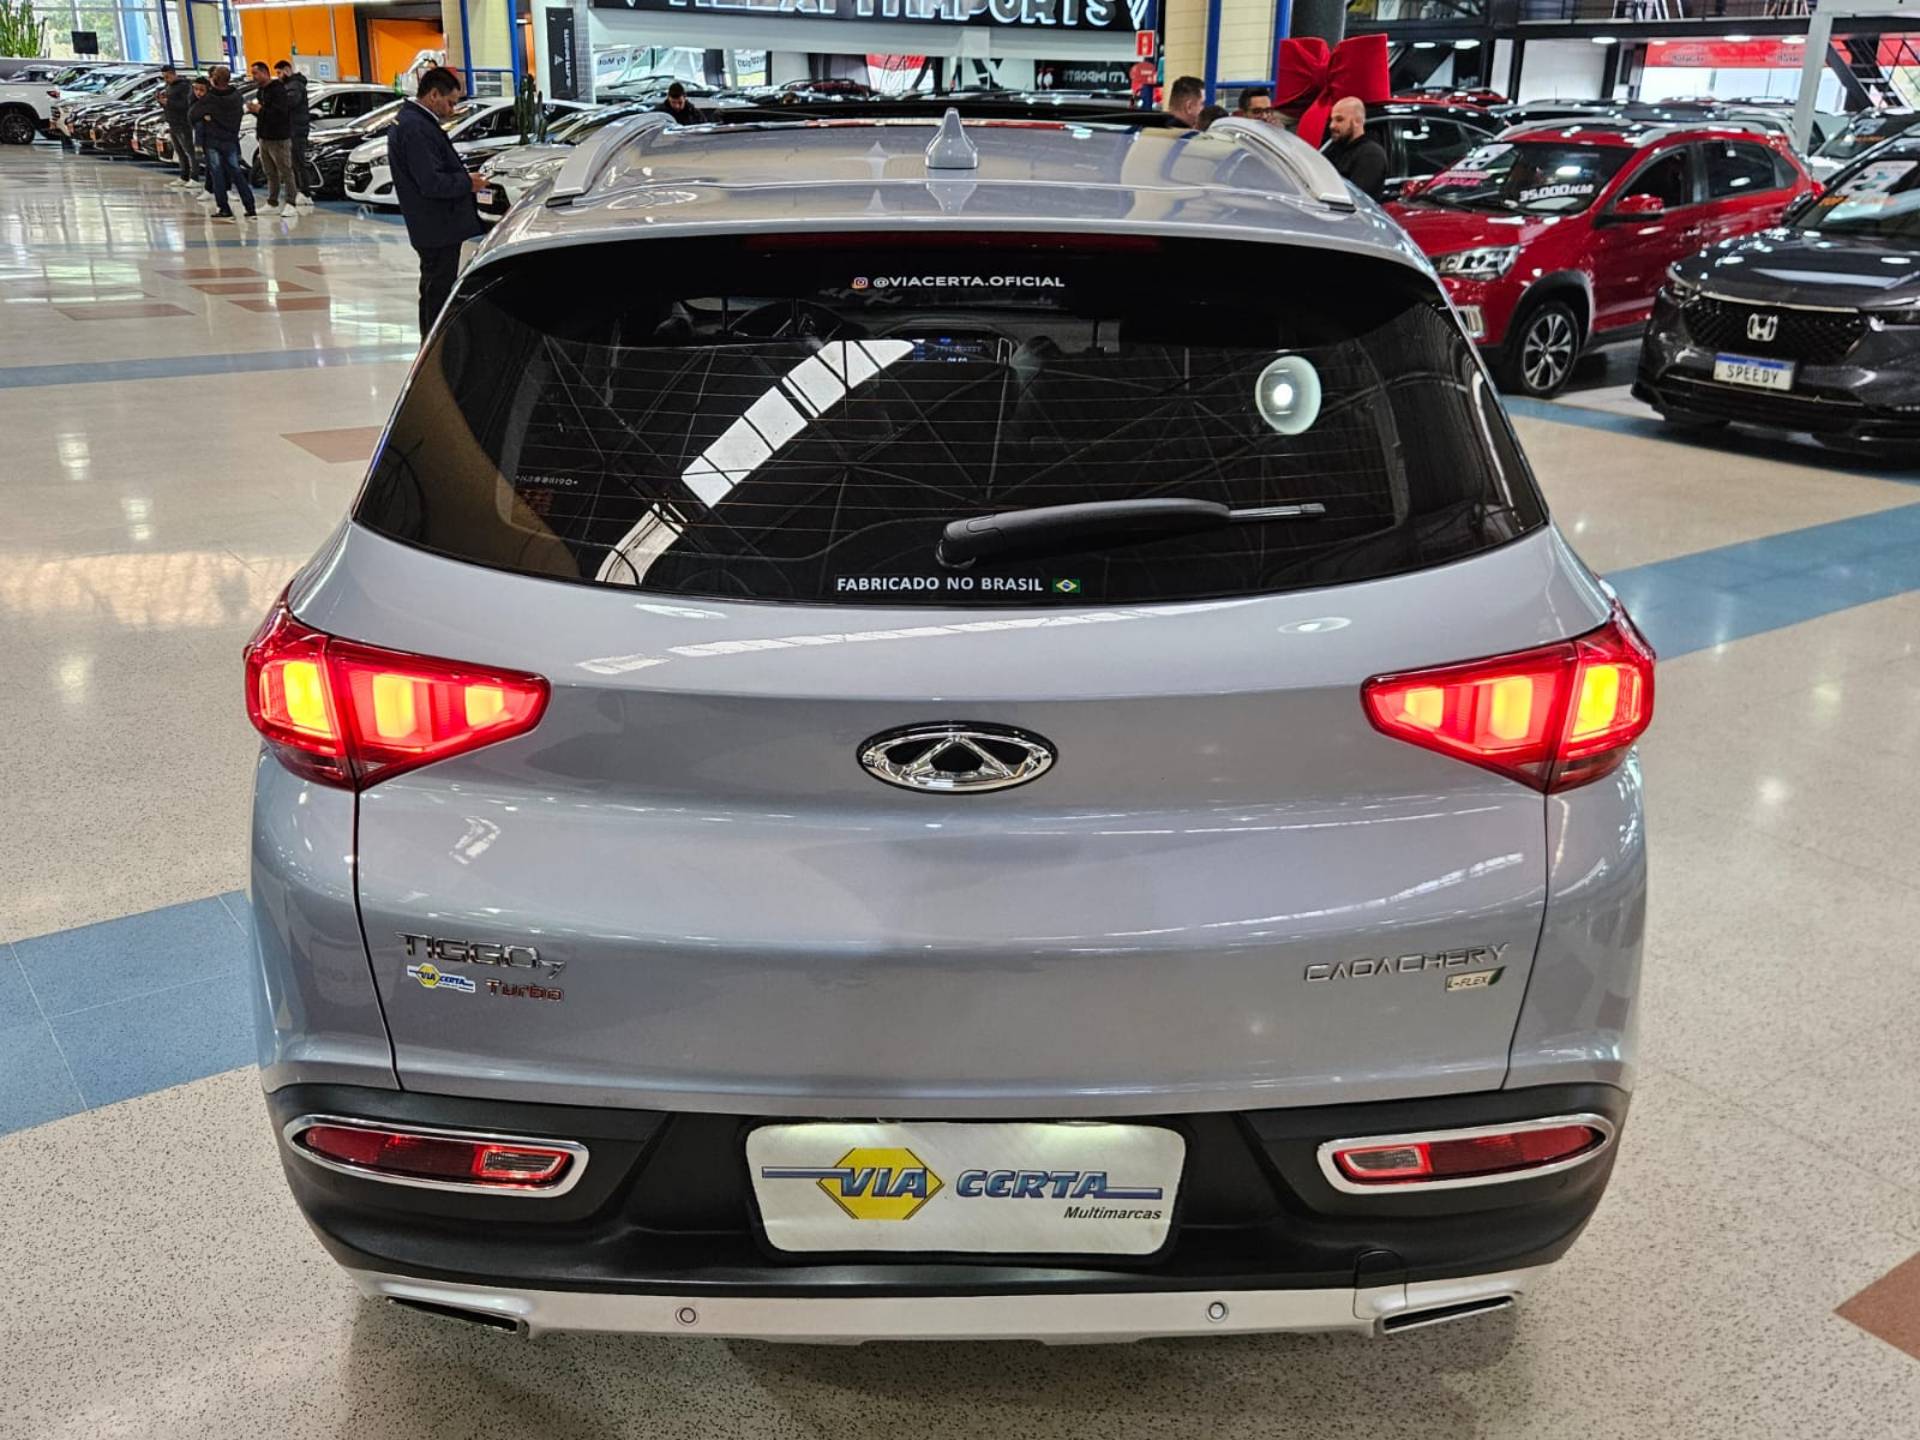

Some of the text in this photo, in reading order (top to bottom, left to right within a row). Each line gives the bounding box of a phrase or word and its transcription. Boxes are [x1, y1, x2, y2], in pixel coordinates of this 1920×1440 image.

[873, 276, 1065, 288] @VIACERTA.OFICIAL
[1726, 364, 1779, 385] SPEEDY
[836, 577, 1044, 592] FABRICADO NO BRASIL
[395, 932, 541, 968] TIGGO
[485, 979, 565, 1002] Turbo
[840, 1167, 1109, 1200] VIA CERTA
[1063, 1205, 1163, 1222] Multimarcas
